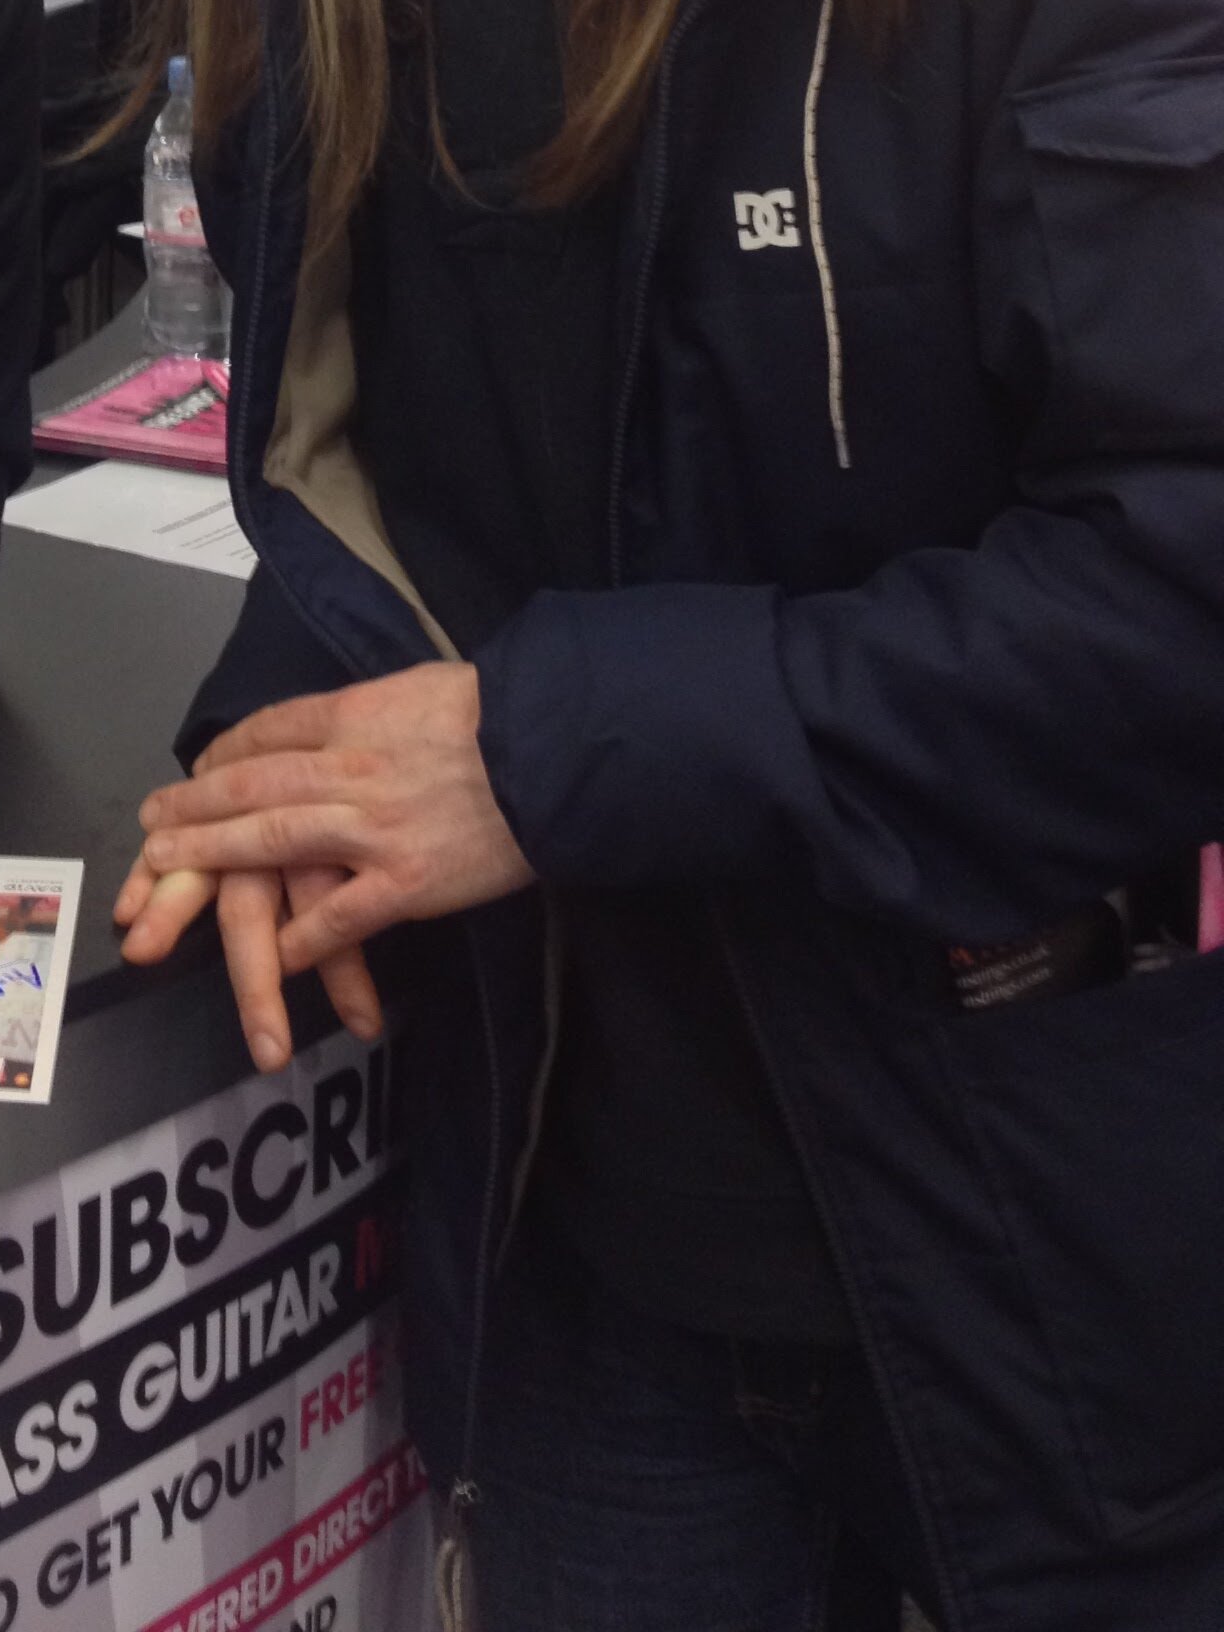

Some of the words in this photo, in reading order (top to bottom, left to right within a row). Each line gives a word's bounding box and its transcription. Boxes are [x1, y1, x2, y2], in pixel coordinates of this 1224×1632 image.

[733, 187, 802, 251] DC
[119, 1242, 340, 1433] GUITAR
[36, 1501, 140, 1608] GET
[151, 1415, 287, 1543] YOUR
[292, 1463, 398, 1585] DIRECT
